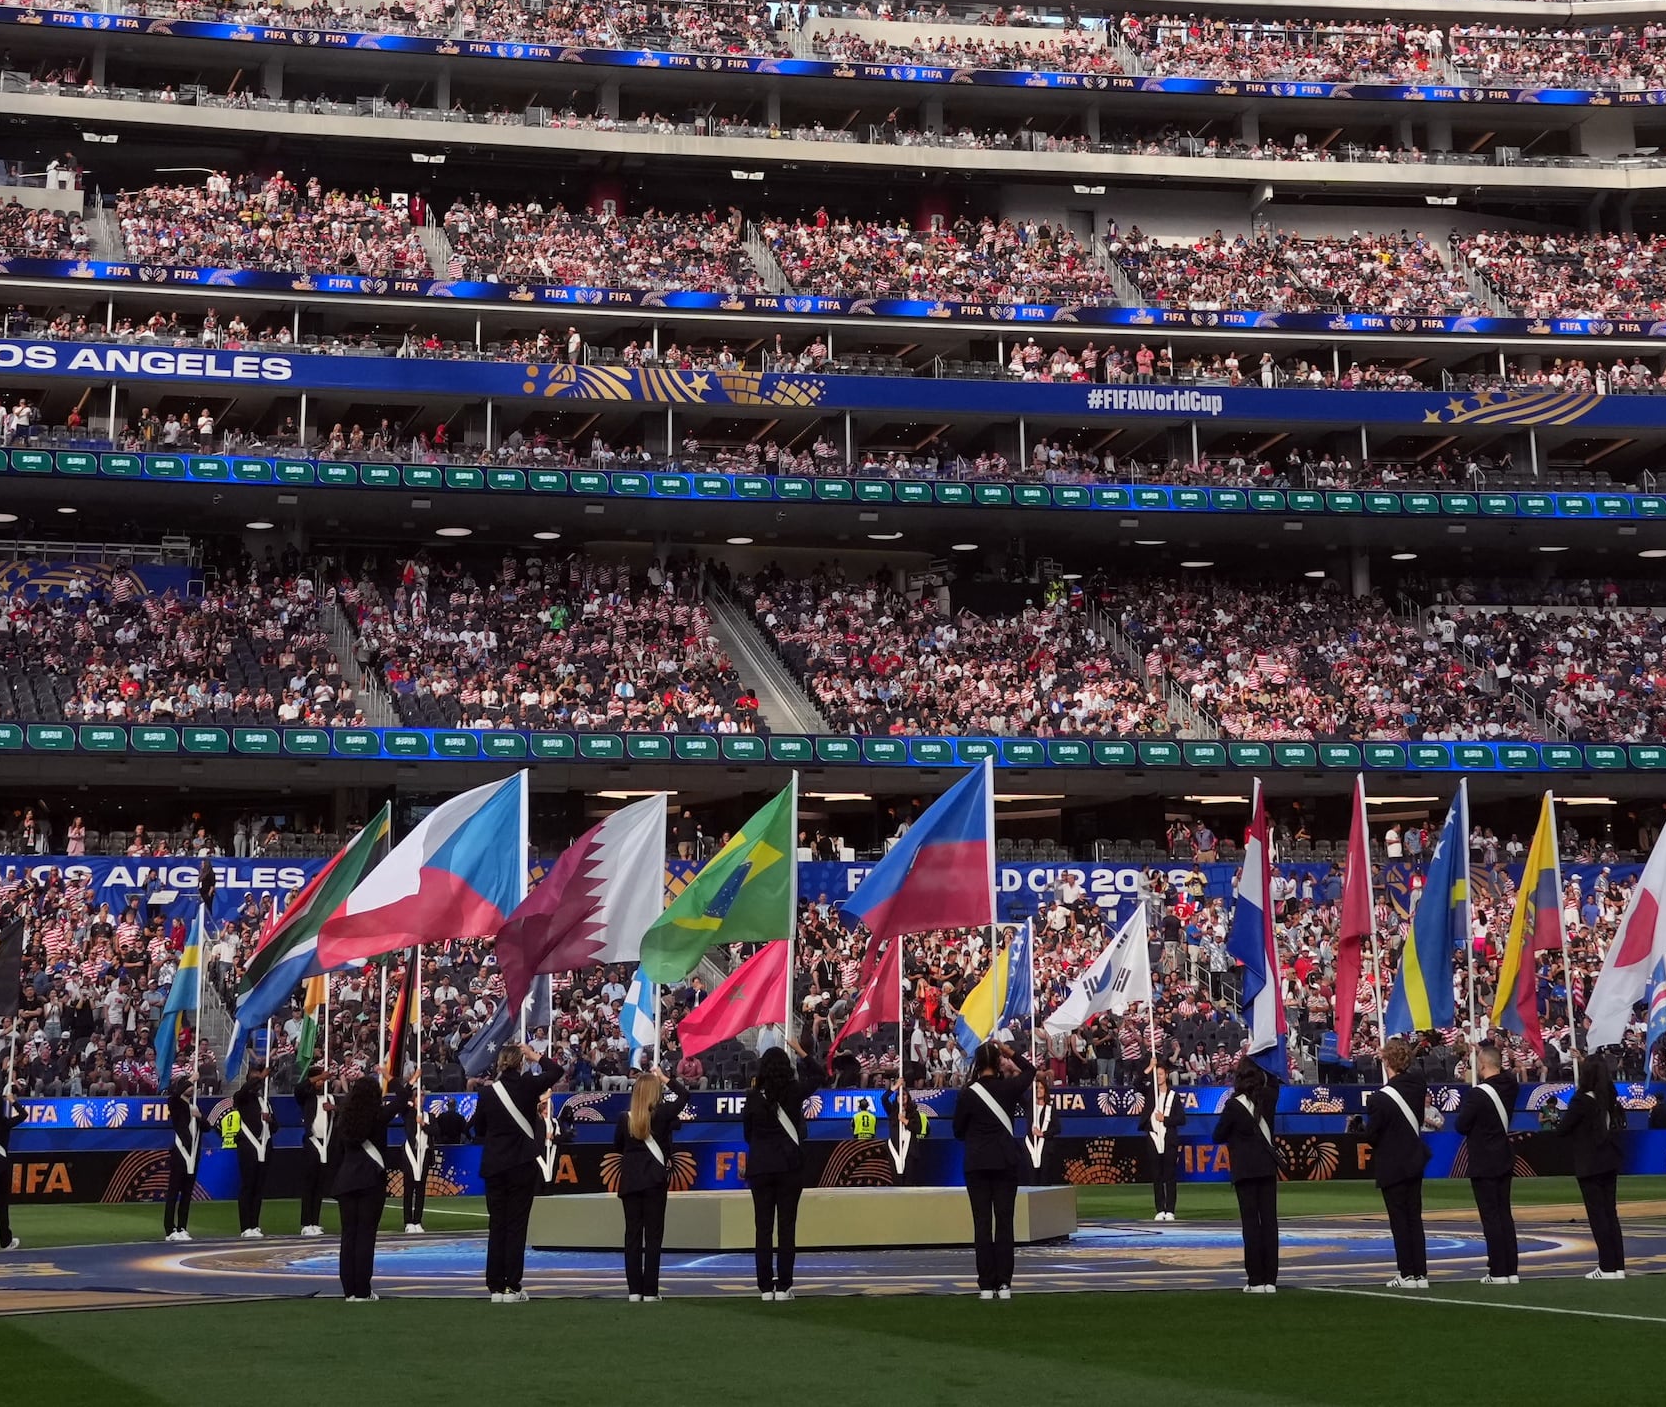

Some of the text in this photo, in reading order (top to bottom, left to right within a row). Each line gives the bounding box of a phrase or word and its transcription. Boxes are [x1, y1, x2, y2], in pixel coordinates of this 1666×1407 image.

[53, 14, 76, 23] FIFA
[116, 19, 139, 28] FIFA
[264, 30, 286, 39] FIFA
[326, 34, 347, 43] FIFA
[470, 44, 491, 53] FIFA
[529, 48, 550, 57] FIFA
[669, 57, 690, 65] FIFA
[728, 60, 749, 68] FIFA
[865, 67, 886, 75] FIFA
[922, 70, 942, 79] FIFA
[1057, 76, 1077, 84] FIFA
[1113, 79, 1133, 87] FIFA
[1246, 84, 1266, 92] FIFA
[1302, 86, 1322, 94] FIFA
[1489, 91, 1509, 99] FIFA
[106, 266, 131, 276] FIFA
[174, 270, 199, 280] FIFA
[329, 279, 353, 288] FIFA
[395, 282, 418, 291] FIFA
[545, 289, 568, 298] FIFA
[609, 292, 632, 302] FIFA
[755, 298, 778, 307] FIFA
[818, 301, 840, 310] FIFA
[961, 306, 983, 315] FIFA
[1022, 308, 1044, 317] FIFA
[1163, 313, 1185, 321] FIFA
[1224, 314, 1245, 323] FIFA
[1362, 318, 1384, 327] FIFA
[1422, 320, 1444, 328] FIFA
[1560, 322, 1582, 331] FIFA
[1619, 324, 1641, 332] FIFA
[67, 349, 293, 381] ANGELES
[1087, 388, 1224, 416] #FIFAWorldCup
[717, 1097, 747, 1113] FIF
[21, 1105, 58, 1122] IFA
[141, 1104, 170, 1121] FI
[1183, 1145, 1231, 1173] IFA
[716, 1152, 746, 1180] FI
[12, 1163, 72, 1193] IFA
